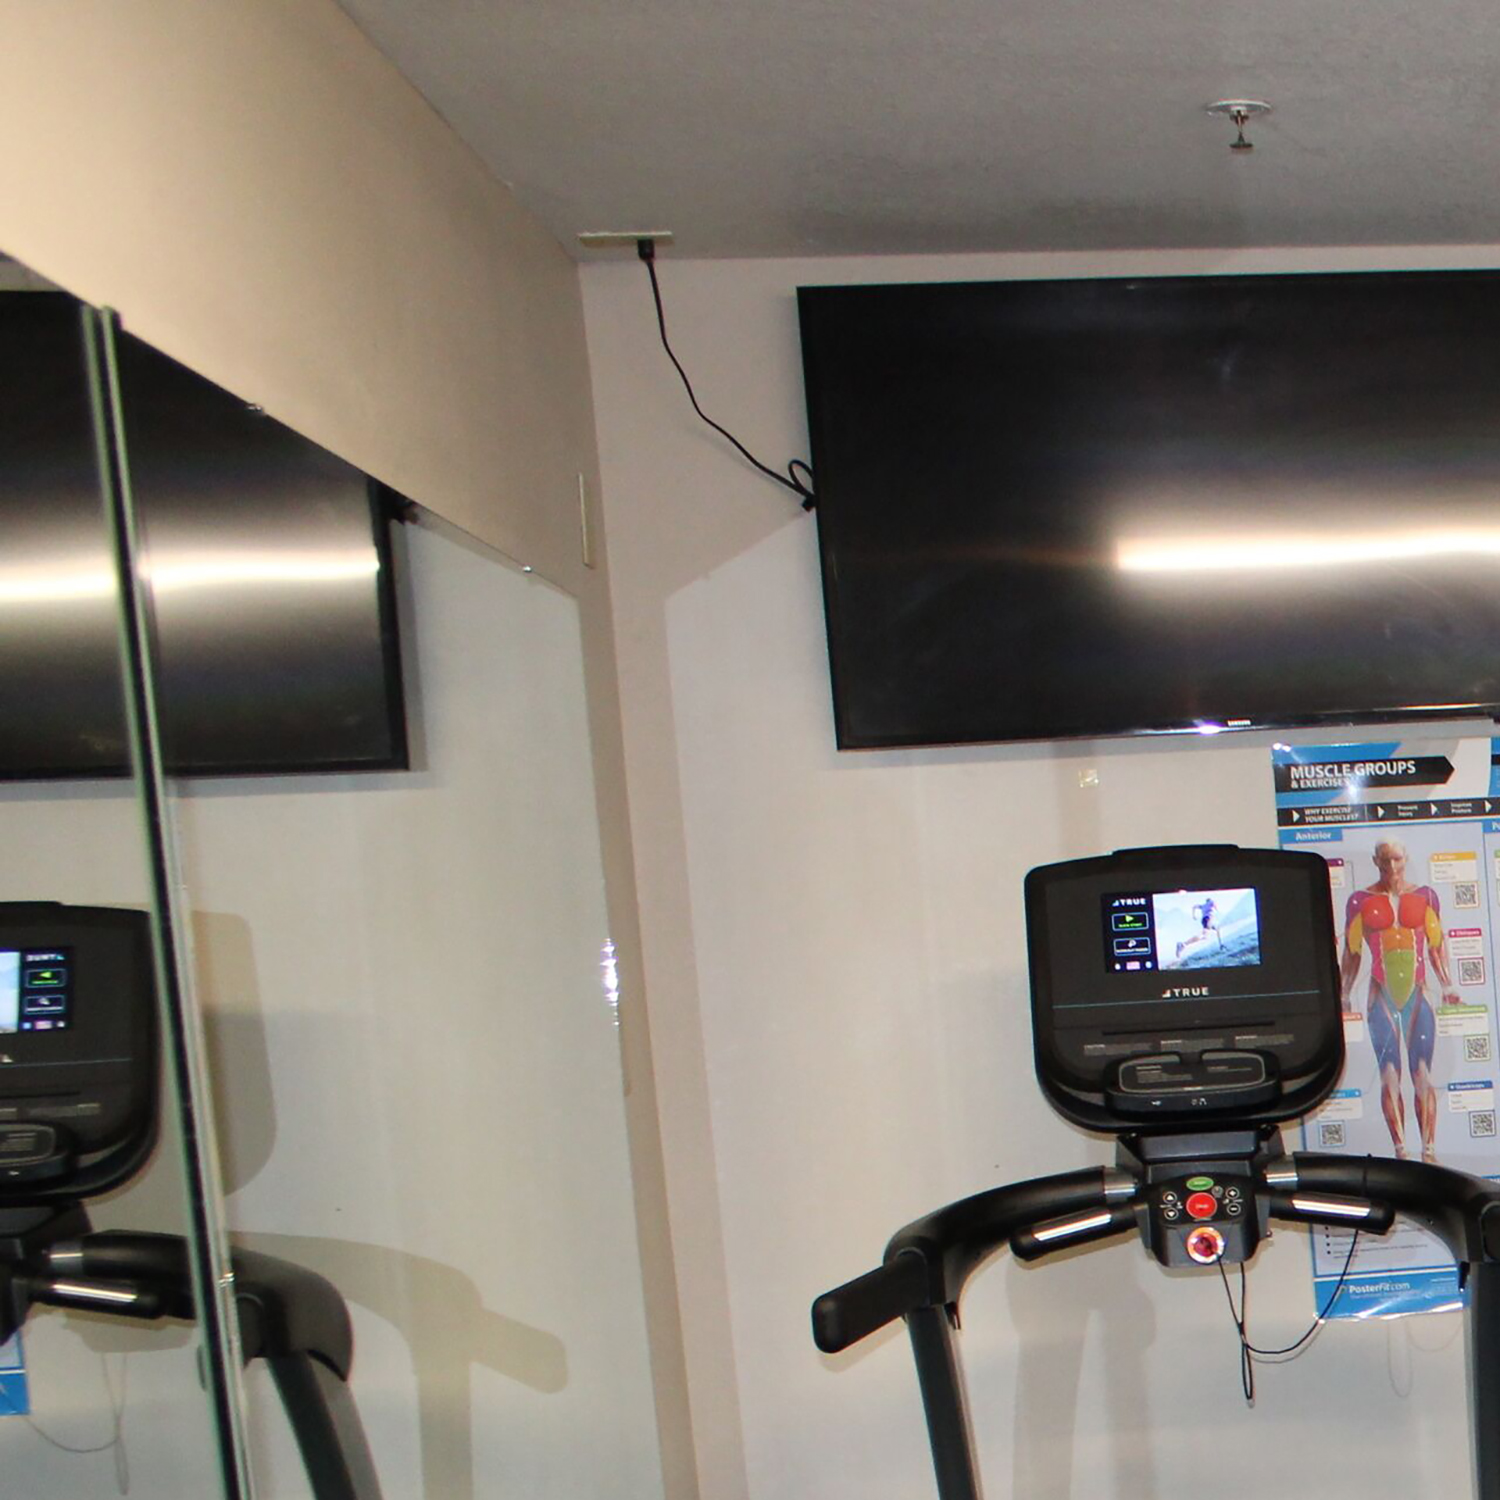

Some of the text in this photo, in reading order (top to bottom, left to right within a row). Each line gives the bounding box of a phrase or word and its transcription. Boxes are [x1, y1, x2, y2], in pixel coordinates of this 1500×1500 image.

[1290, 761, 1416, 780] MUSCLE GROUPS
[1295, 832, 1331, 841] Anterior
[1120, 897, 1146, 906] TRUE
[1172, 987, 1209, 997] TRUE
